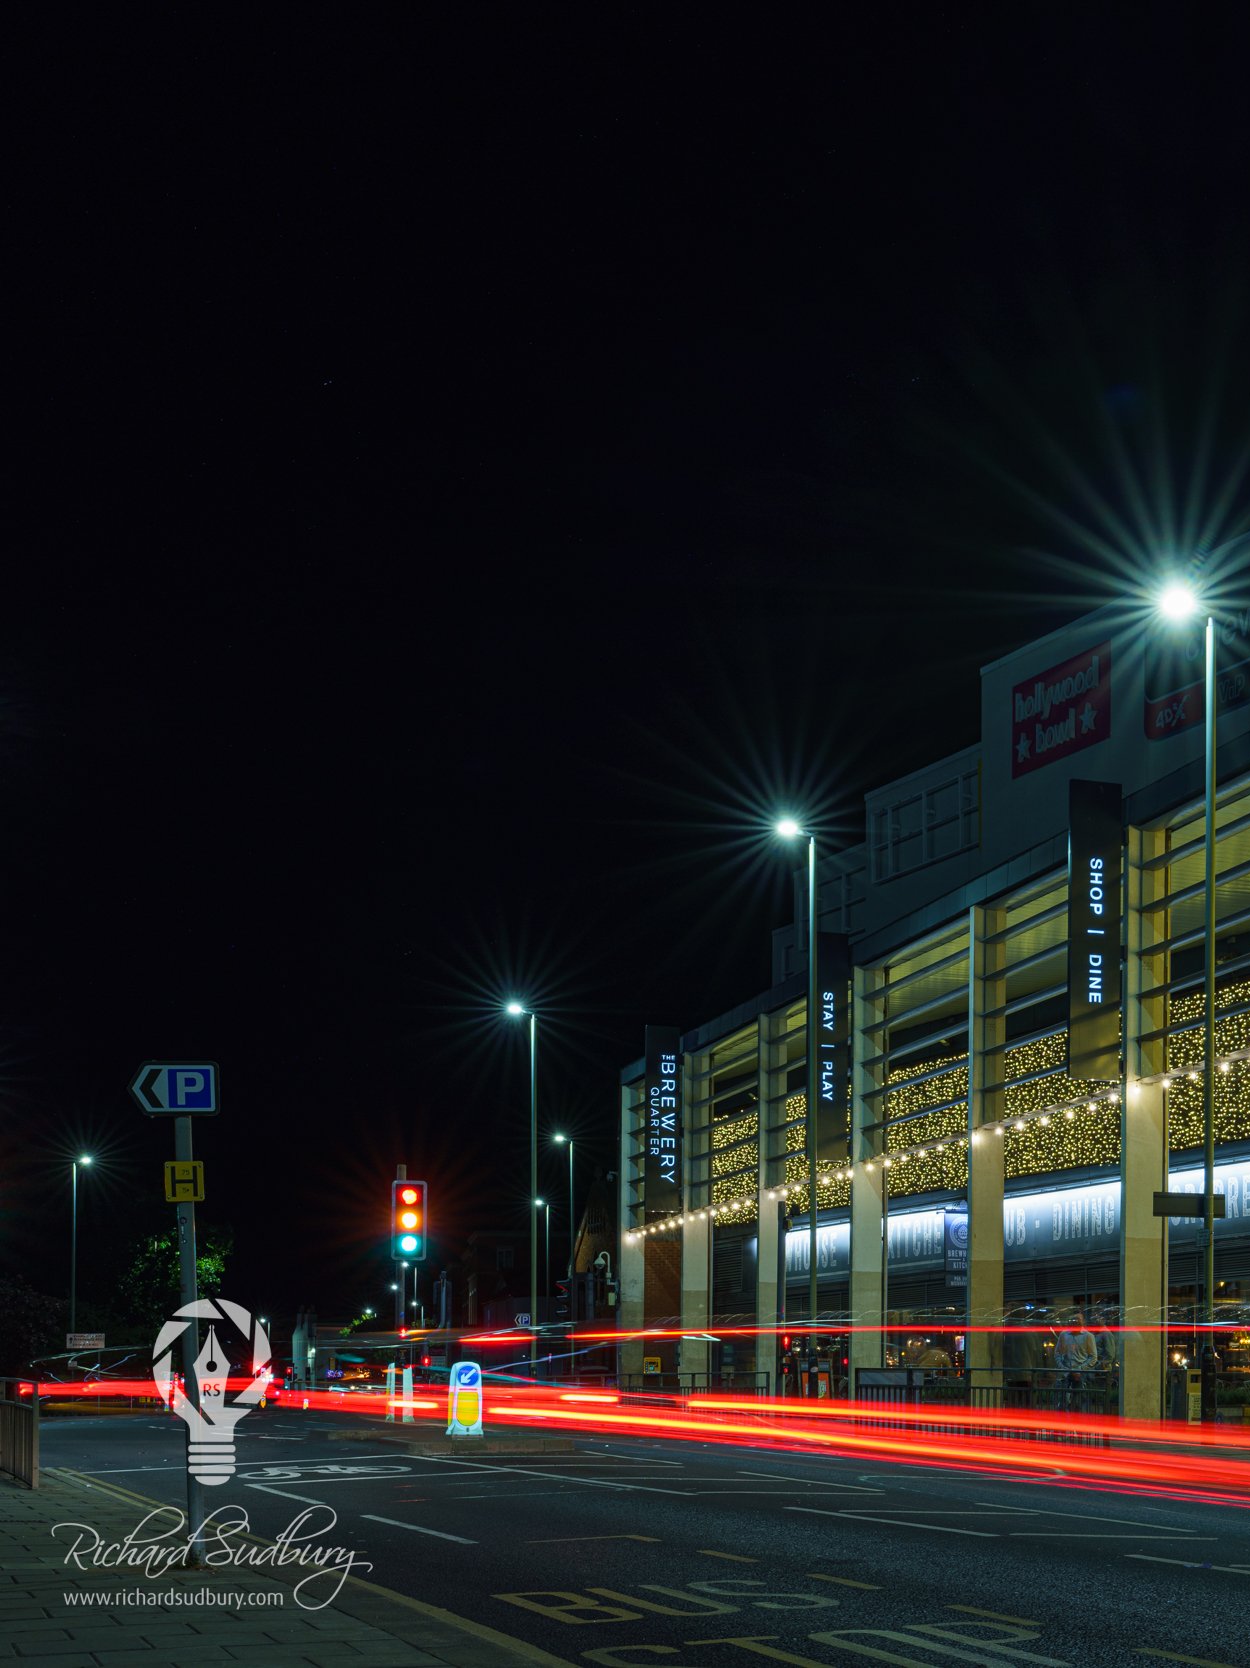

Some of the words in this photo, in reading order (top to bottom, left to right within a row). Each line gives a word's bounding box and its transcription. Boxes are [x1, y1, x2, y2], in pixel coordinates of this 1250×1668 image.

[1015, 655, 1100, 722] hollywood
[1035, 707, 1077, 753] bowl
[1089, 857, 1103, 915] SHOP
[1088, 954, 1102, 1004] DINE
[823, 991, 834, 1031] STAY
[176, 1071, 205, 1106] P
[822, 1061, 833, 1101] PLAY
[650, 1087, 660, 1156] QUARTER
[660, 1061, 676, 1184] BREWERY
[170, 1165, 198, 1197] H
[1052, 1195, 1115, 1241] DINING
[489, 1579, 840, 1625] BUS
